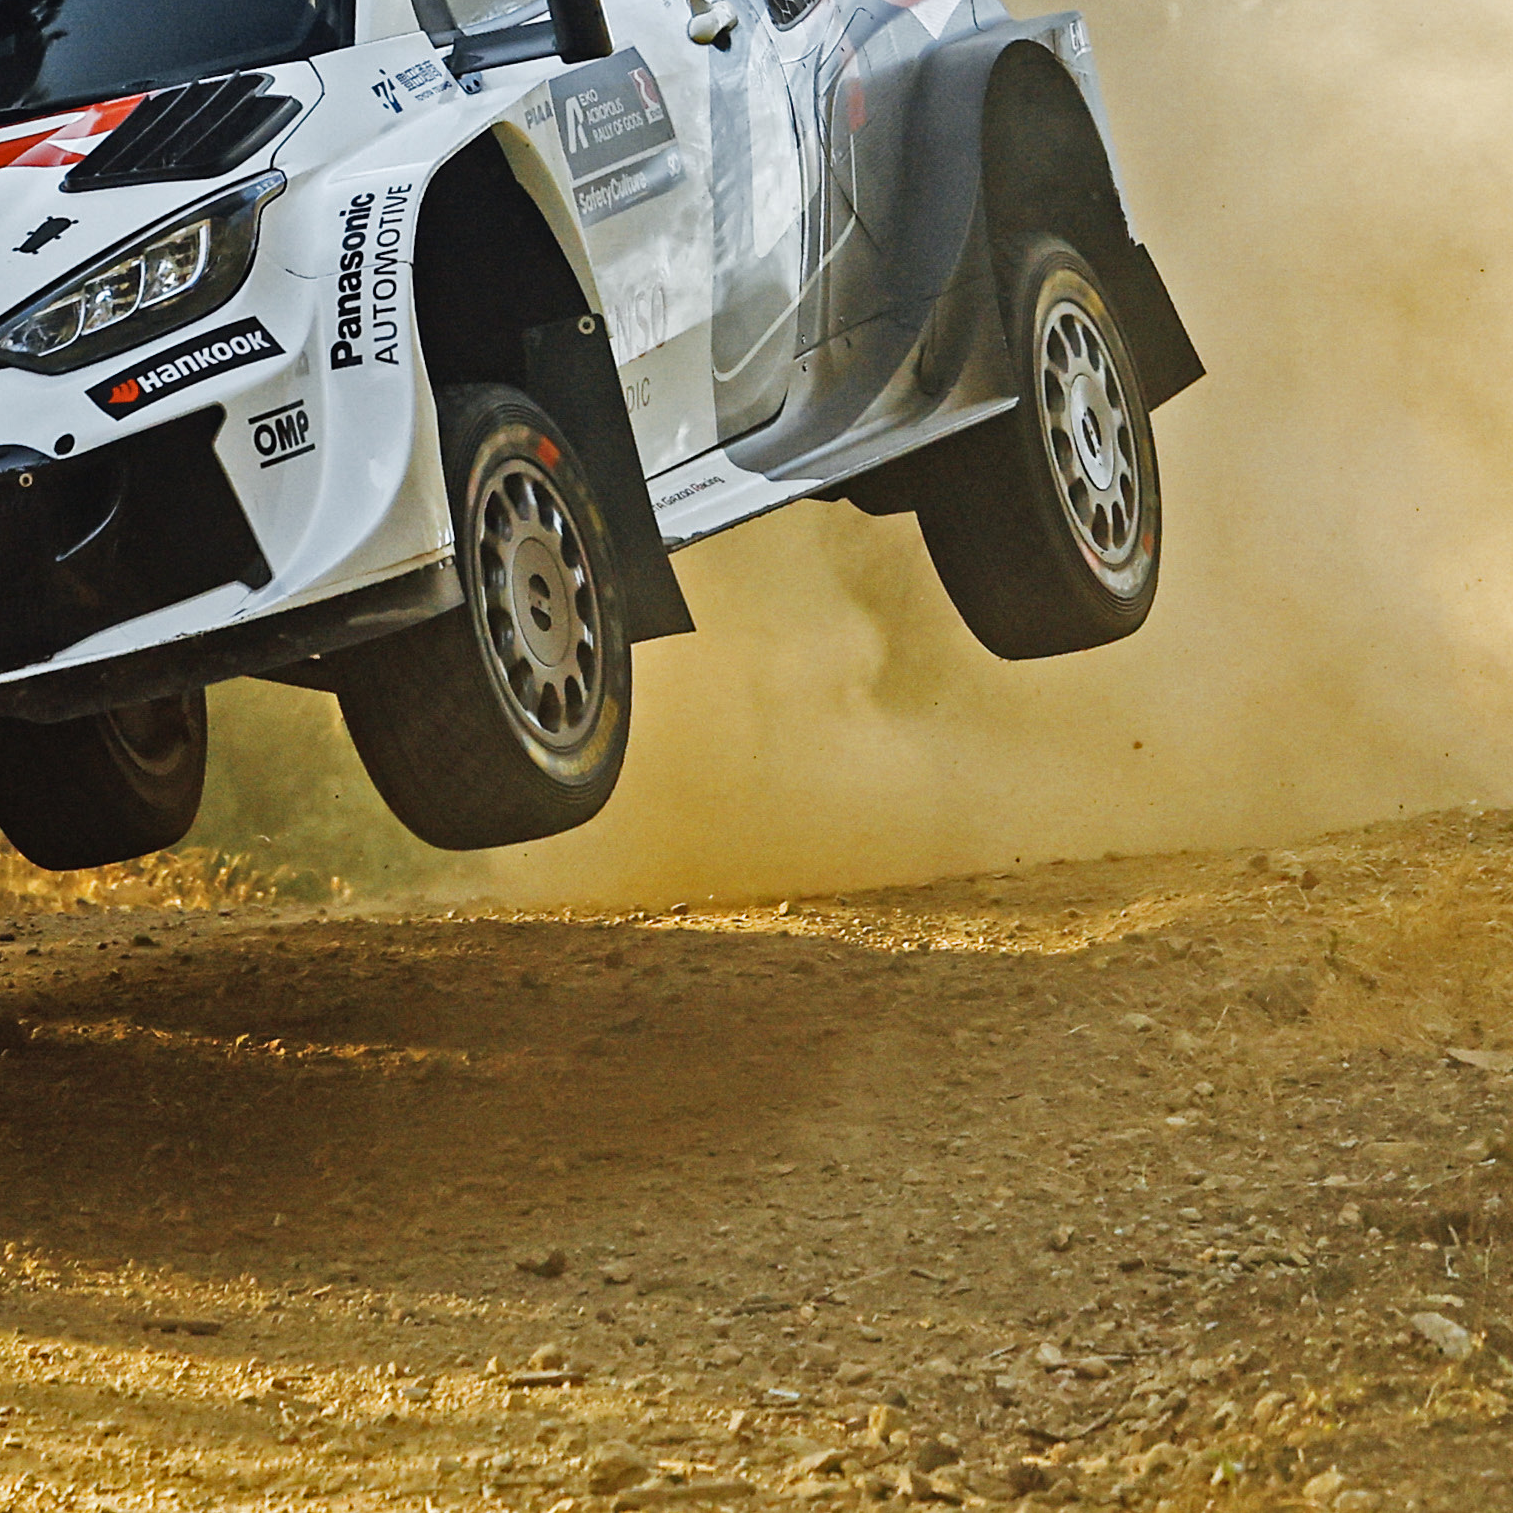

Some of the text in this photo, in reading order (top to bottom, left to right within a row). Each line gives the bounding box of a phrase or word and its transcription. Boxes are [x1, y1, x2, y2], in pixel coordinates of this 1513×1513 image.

[578, 88, 598, 106] EKO
[592, 111, 644, 144] RALLY OF GODS
[578, 171, 648, 214] SafetyCulture
[330, 191, 376, 371] Panasonic
[372, 183, 413, 366] AUTOMOTIVE
[253, 409, 309, 457] OMP
